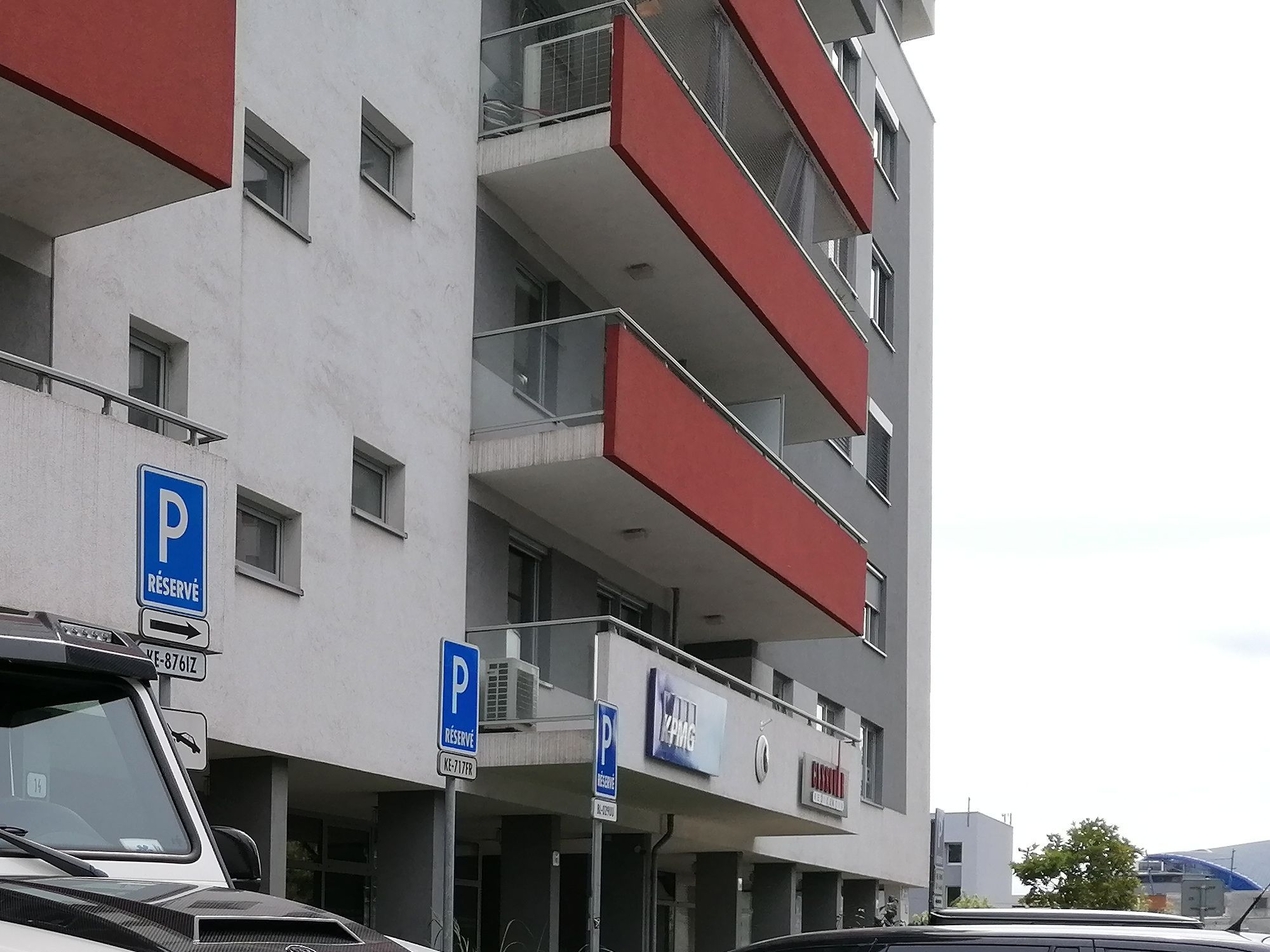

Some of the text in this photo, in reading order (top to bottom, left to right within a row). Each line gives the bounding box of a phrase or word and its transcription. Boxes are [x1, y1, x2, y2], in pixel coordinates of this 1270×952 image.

[159, 488, 188, 563] P
[147, 570, 199, 602] RÉSERVÉ
[451, 655, 469, 714] P
[444, 725, 474, 749] RÉSERVÉ
[601, 714, 612, 766] P
[443, 757, 473, 776] KE-717FR
